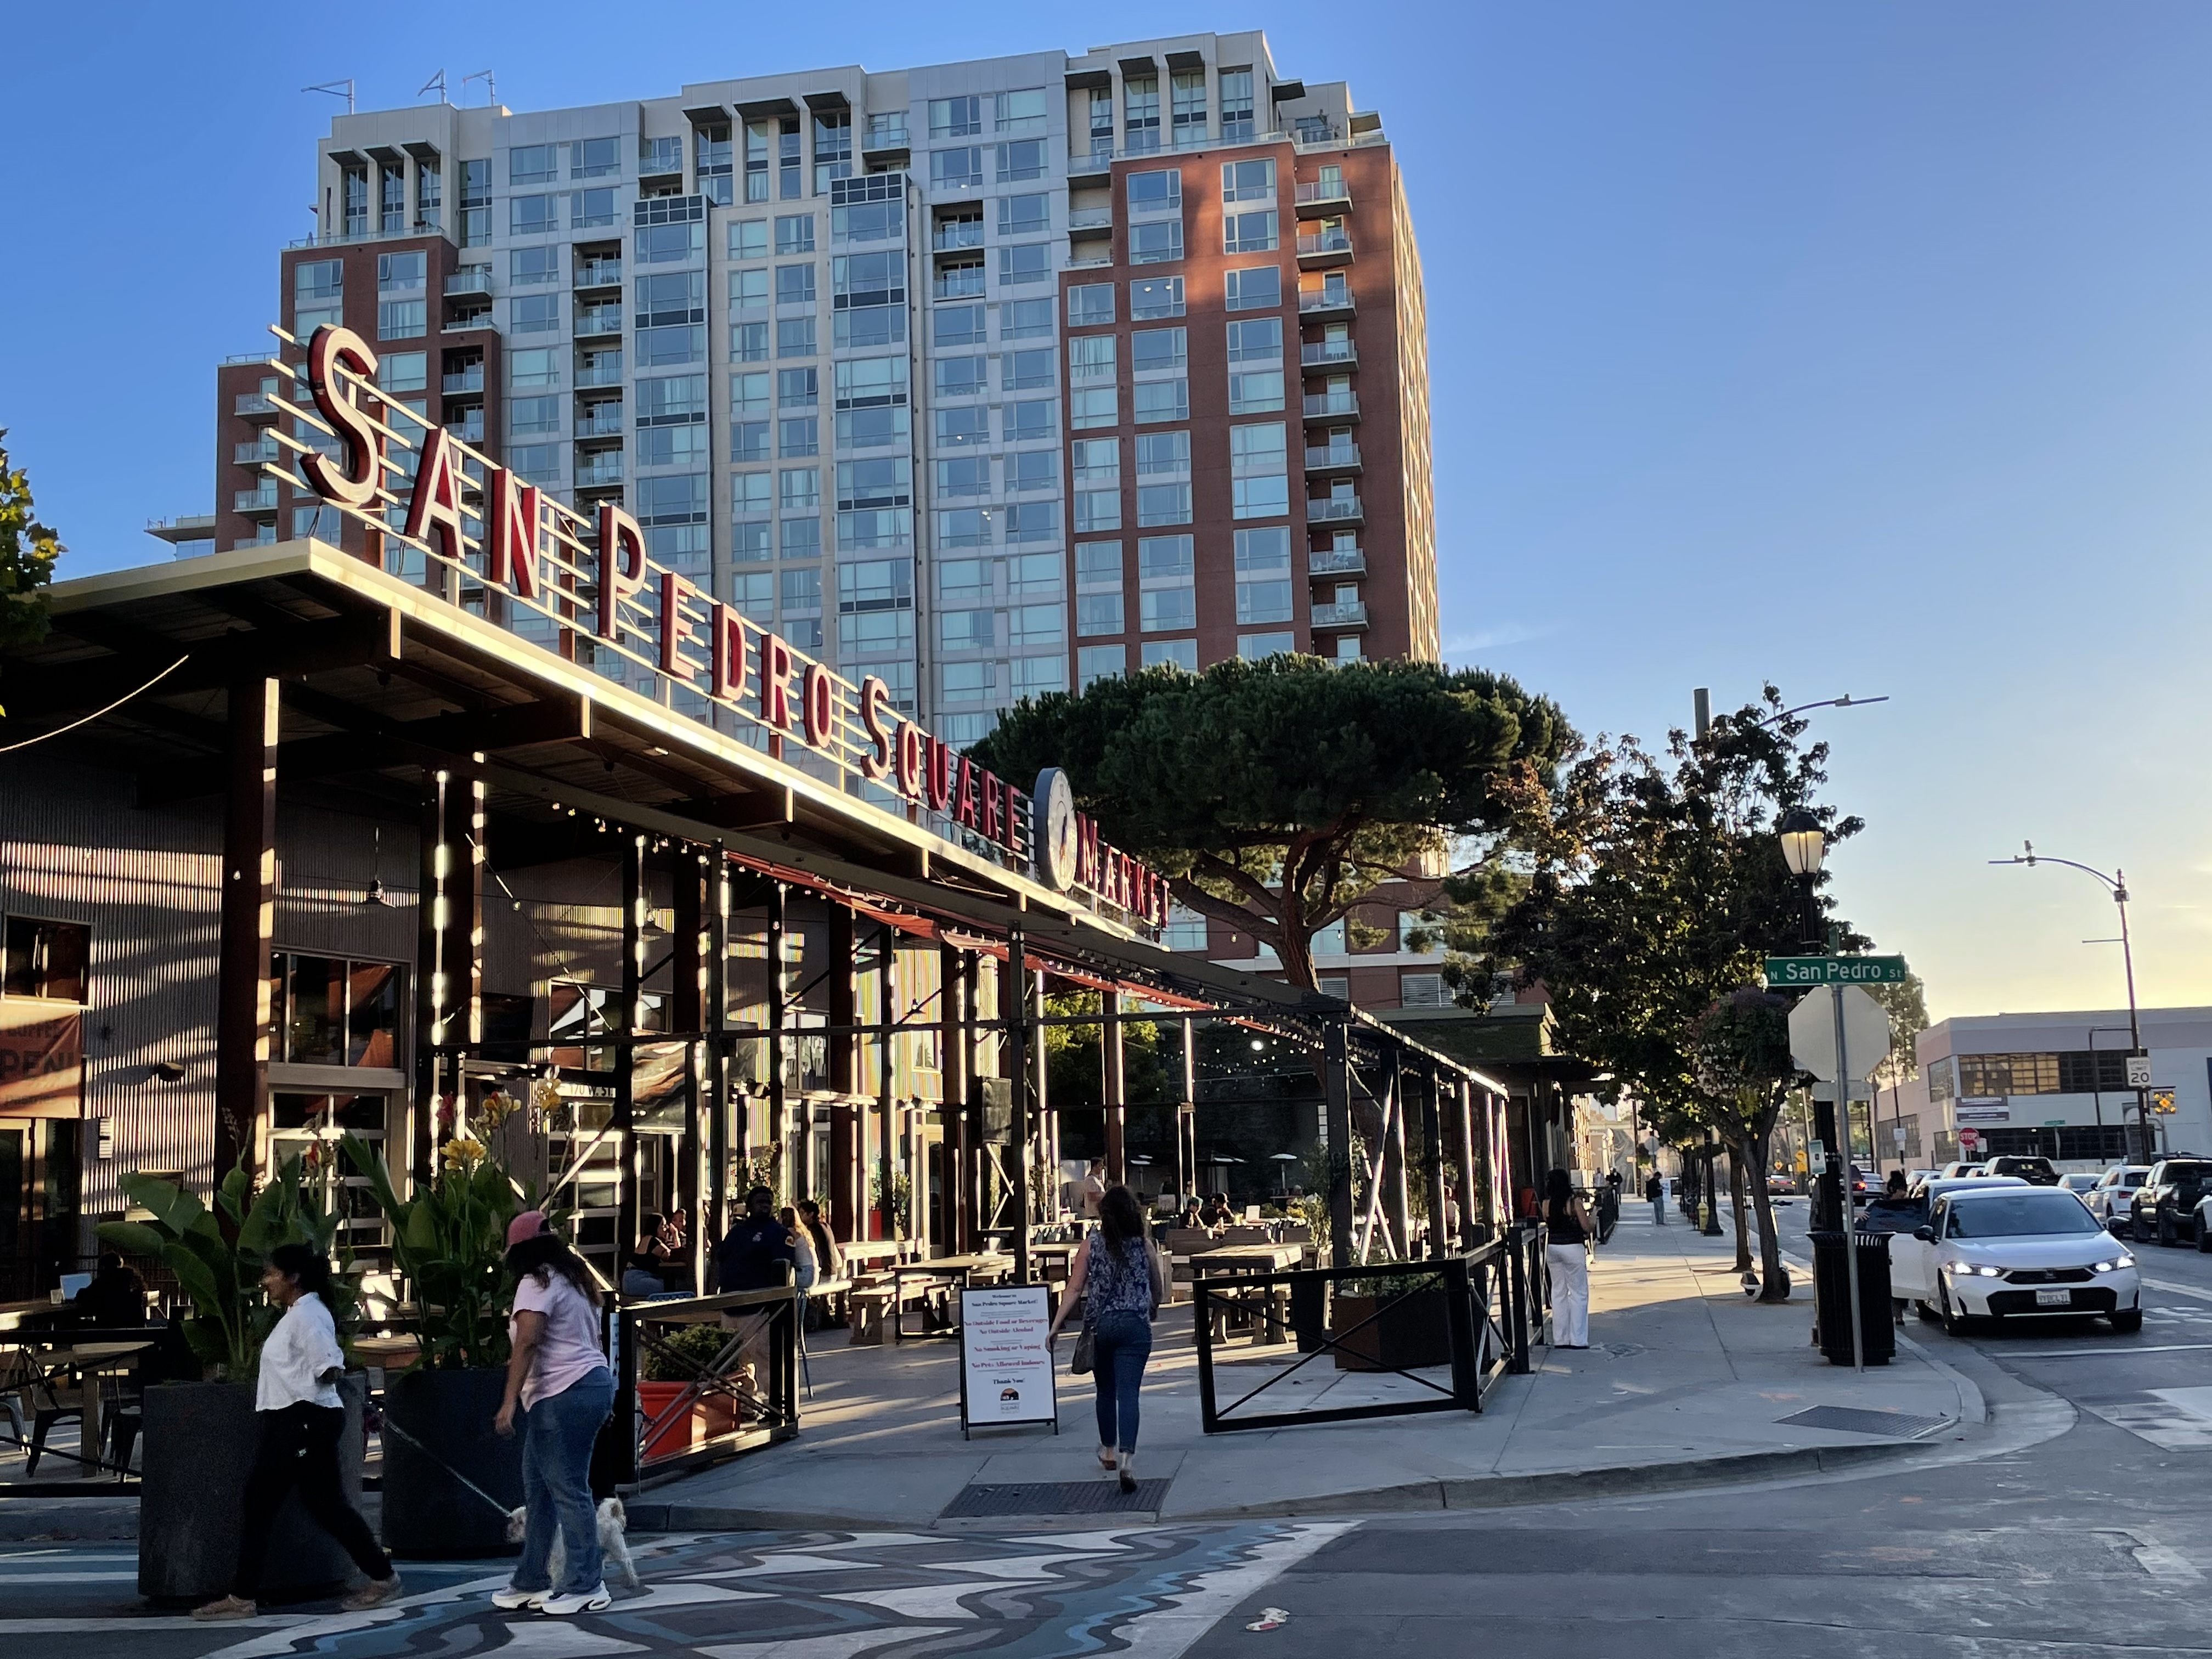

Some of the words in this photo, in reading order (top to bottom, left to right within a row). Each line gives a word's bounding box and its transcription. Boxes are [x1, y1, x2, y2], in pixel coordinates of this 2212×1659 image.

[299, 323, 541, 600] SAN
[598, 504, 833, 748] PEDRO
[860, 675, 1023, 851] SQUARE
[1075, 810, 1170, 928] MARKET
[1770, 970, 1778, 980] N
[1786, 963, 1821, 980] San
[1826, 962, 1881, 979] Pedro
[1889, 969, 1902, 978] St
[2131, 1072, 2149, 1083] 20
